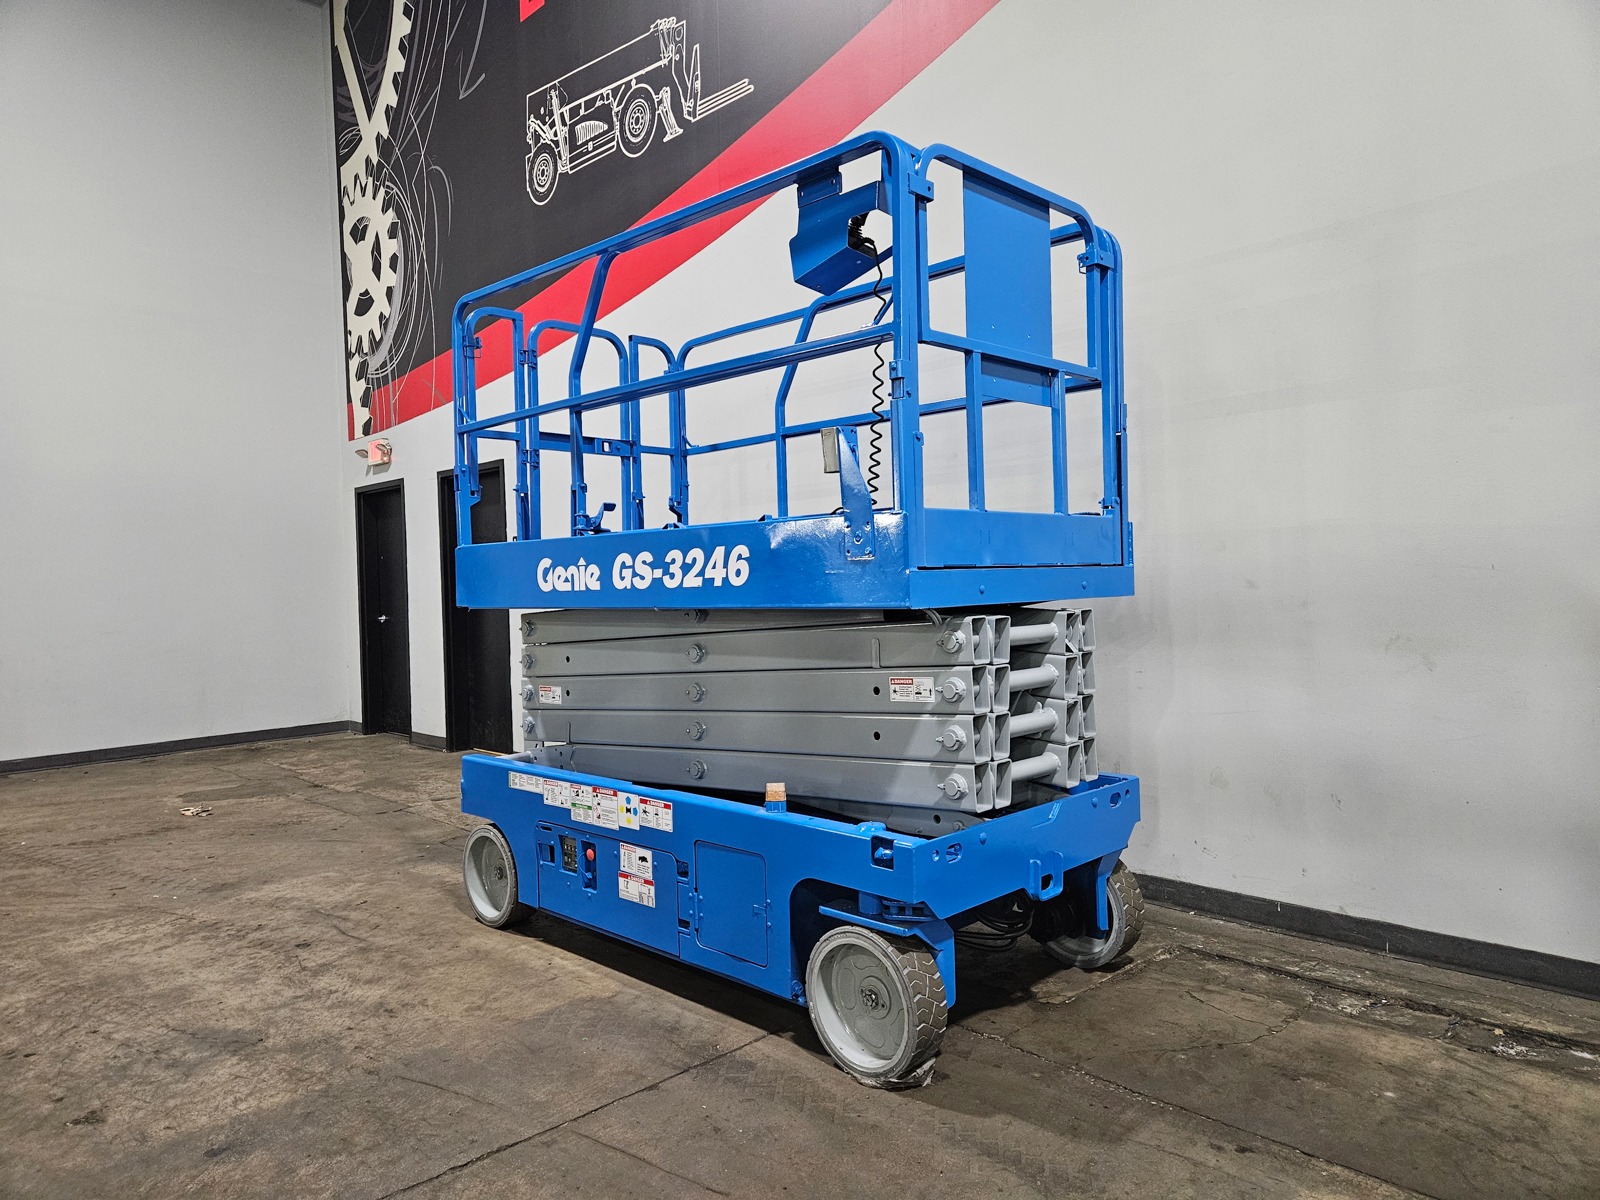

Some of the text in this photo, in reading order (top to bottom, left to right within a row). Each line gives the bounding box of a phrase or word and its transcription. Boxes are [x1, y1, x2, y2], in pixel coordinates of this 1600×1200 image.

[536, 544, 750, 593] Genie GS-3246
[600, 787, 614, 796] DANGER
[650, 800, 665, 808] DANGER
